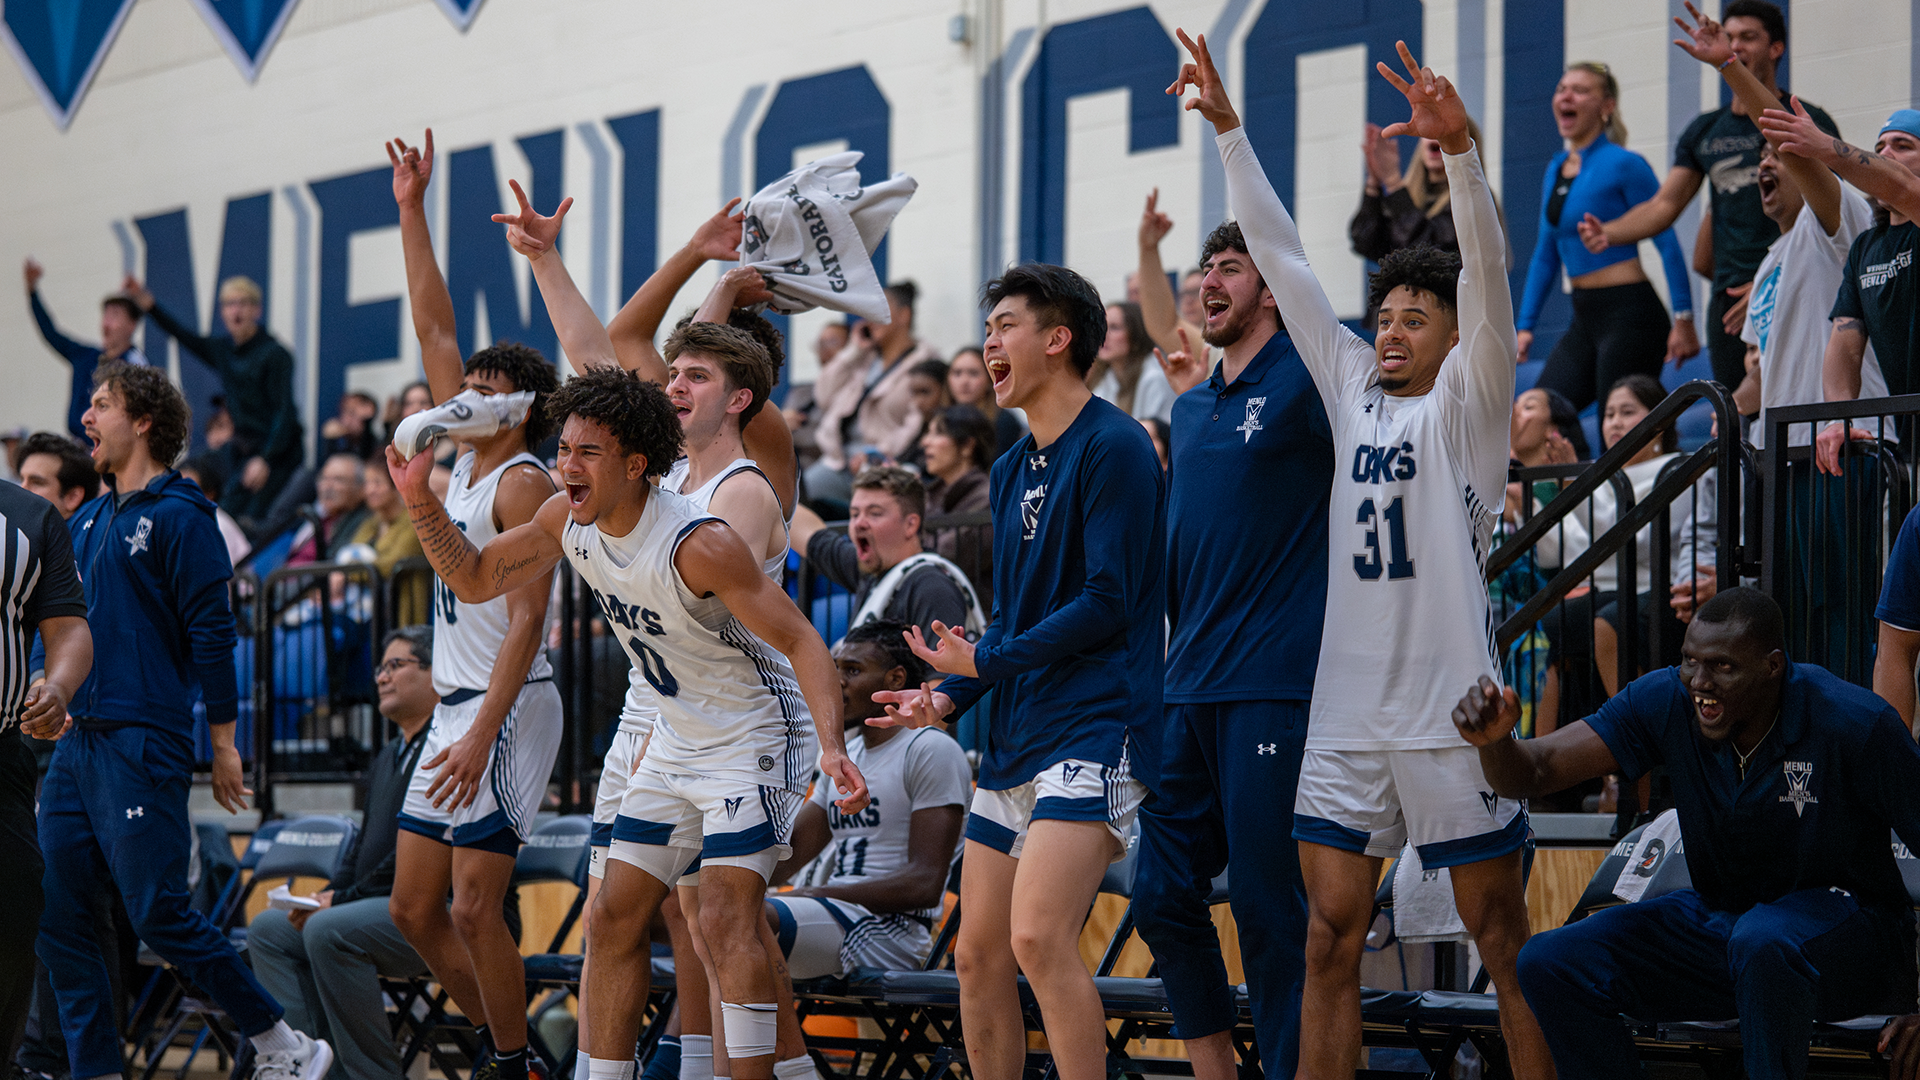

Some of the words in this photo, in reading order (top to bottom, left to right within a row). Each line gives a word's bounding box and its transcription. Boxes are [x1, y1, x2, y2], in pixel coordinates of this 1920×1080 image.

[1352, 495, 1417, 582] 31
[627, 635, 681, 698] 0
[1783, 761, 1813, 772] MENLO
